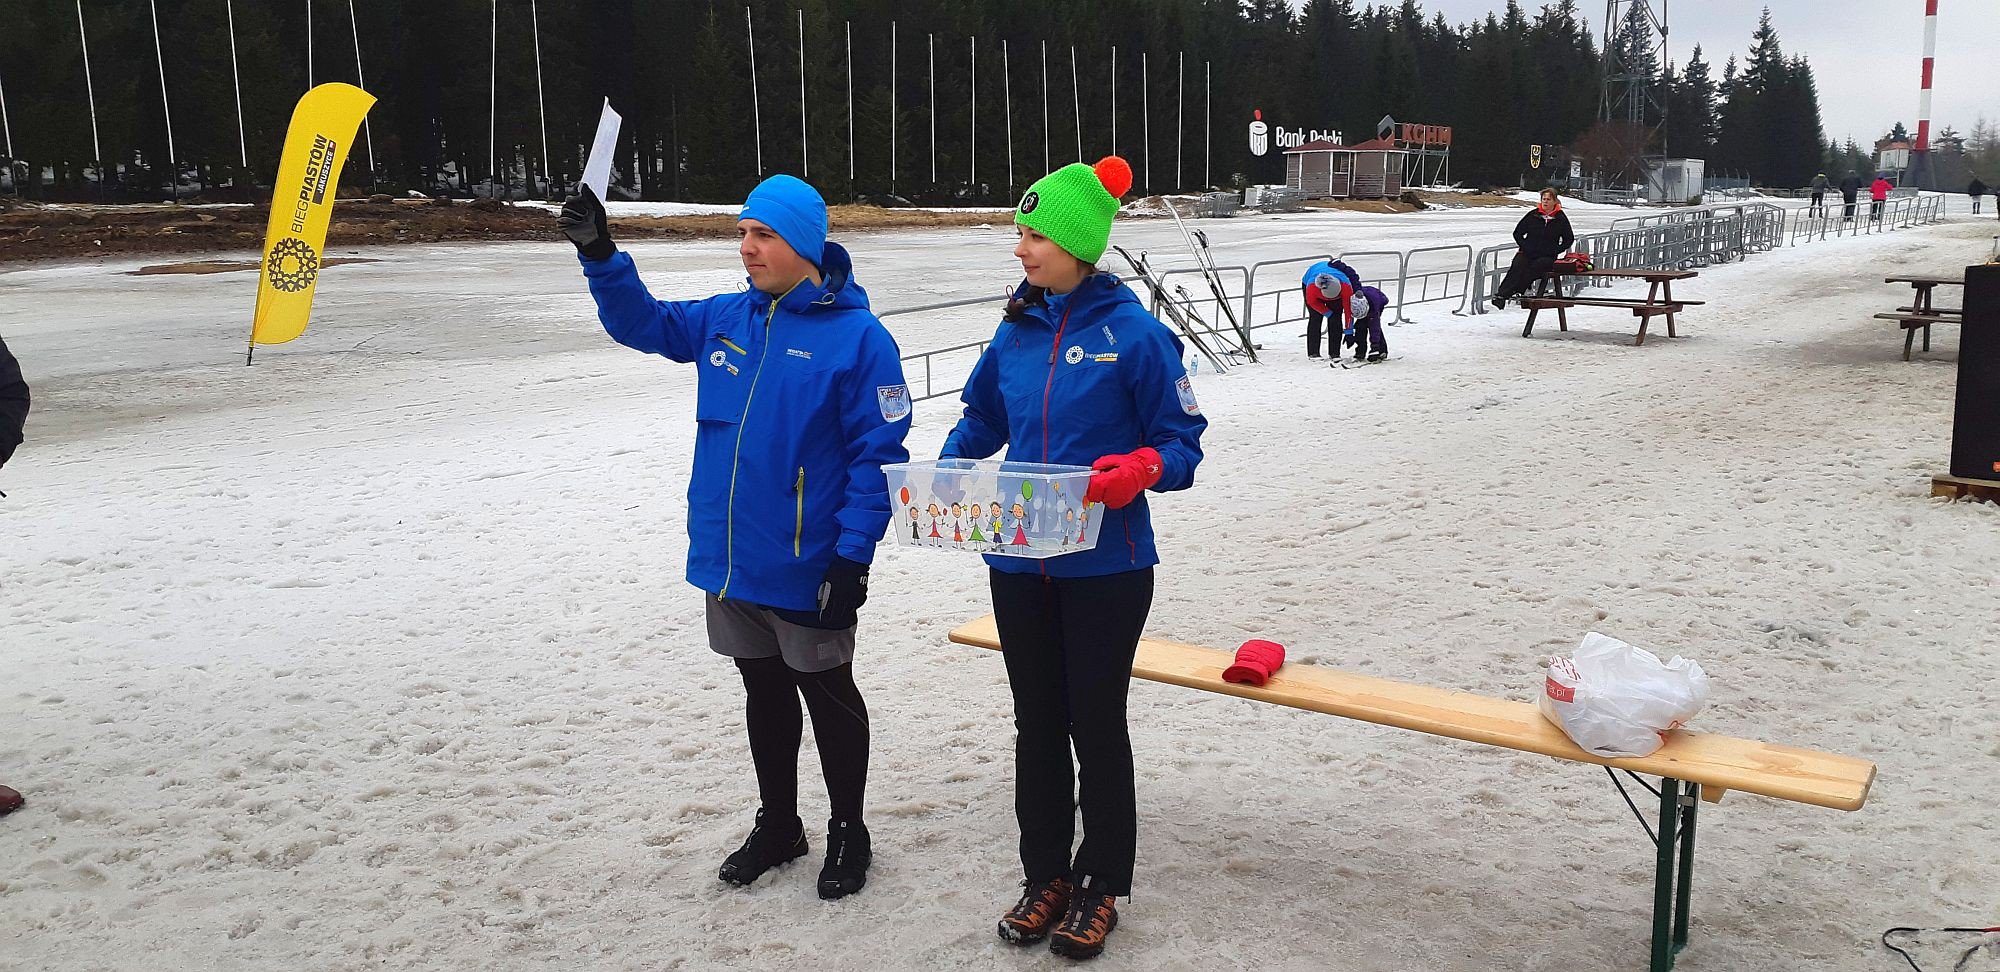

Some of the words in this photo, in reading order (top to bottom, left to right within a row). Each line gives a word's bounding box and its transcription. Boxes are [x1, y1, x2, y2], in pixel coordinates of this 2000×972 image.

[1275, 126, 1307, 148] Bank
[1402, 122, 1452, 145] KGHM
[291, 133, 328, 233] BIEGPIASTÓW
[316, 150, 334, 194] JAKUSZYCE
